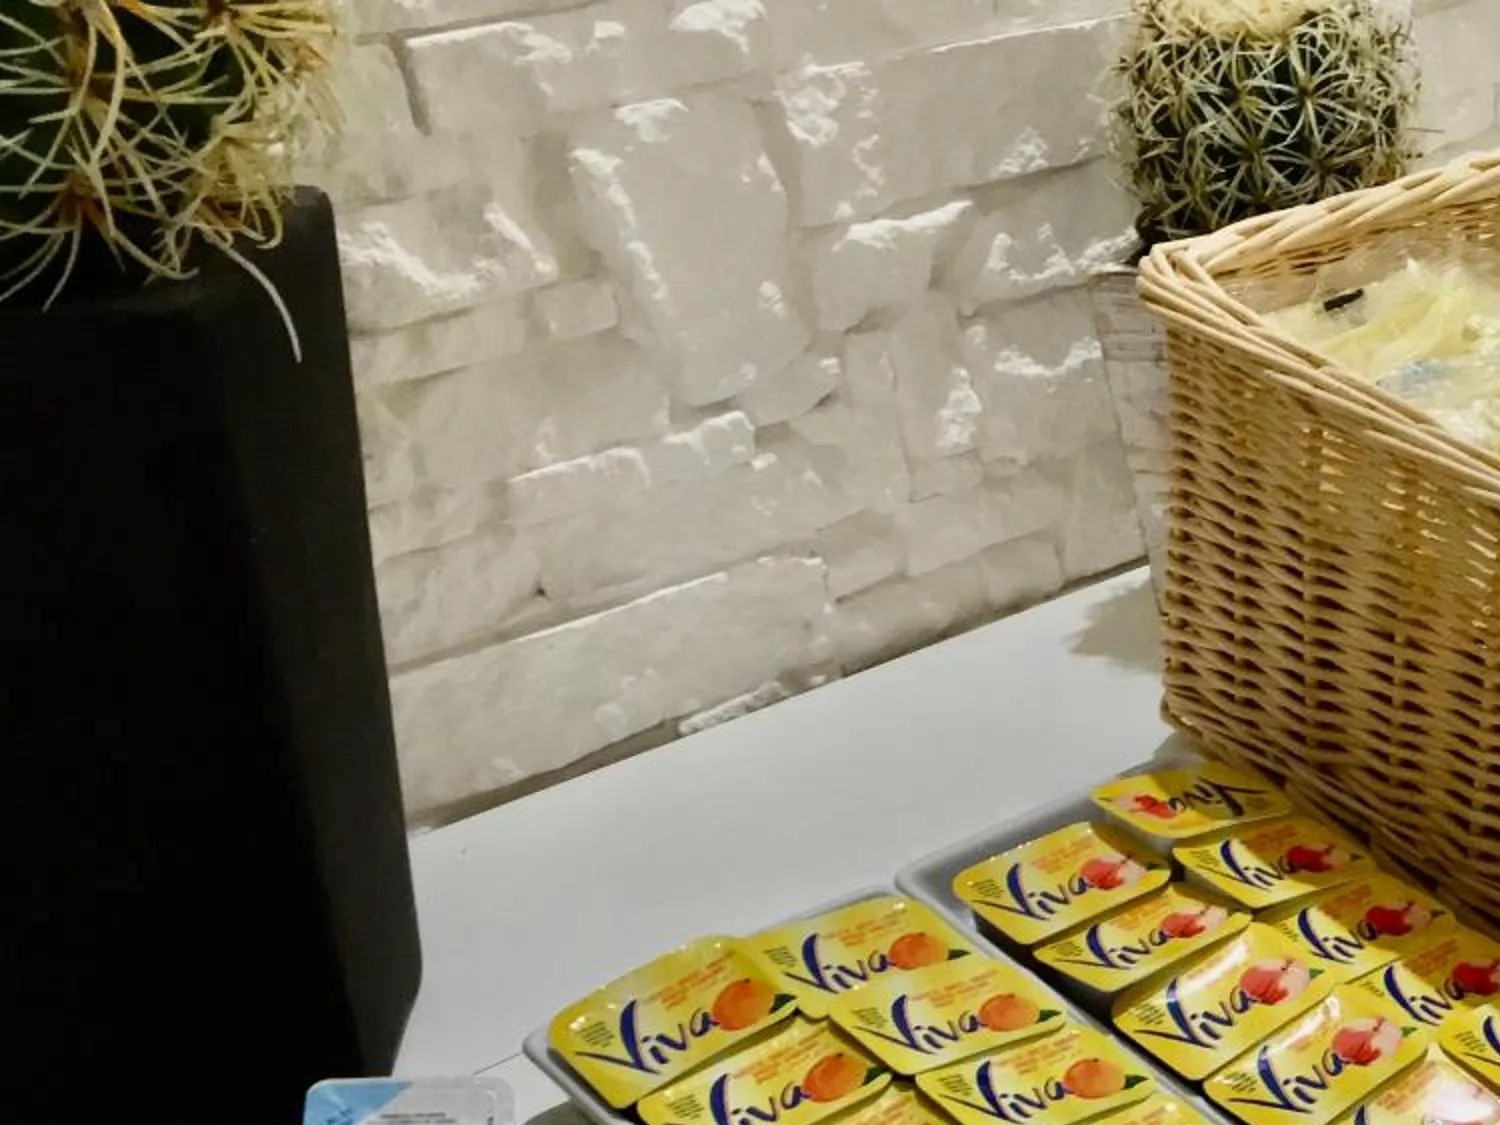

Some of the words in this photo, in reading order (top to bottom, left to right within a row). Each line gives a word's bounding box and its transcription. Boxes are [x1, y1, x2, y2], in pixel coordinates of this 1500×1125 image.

[984, 863, 1092, 920] Viva
[1190, 839, 1293, 892] Viva
[785, 934, 892, 993] Viva
[1055, 924, 1168, 970] Viva
[1298, 908, 1381, 964] Viva
[852, 995, 986, 1054] Viva
[1134, 978, 1259, 1049] Viva
[1384, 964, 1468, 1026] Viva
[576, 1000, 720, 1074] Viva
[940, 1061, 1071, 1124] Viva
[1228, 1046, 1350, 1114] Viva
